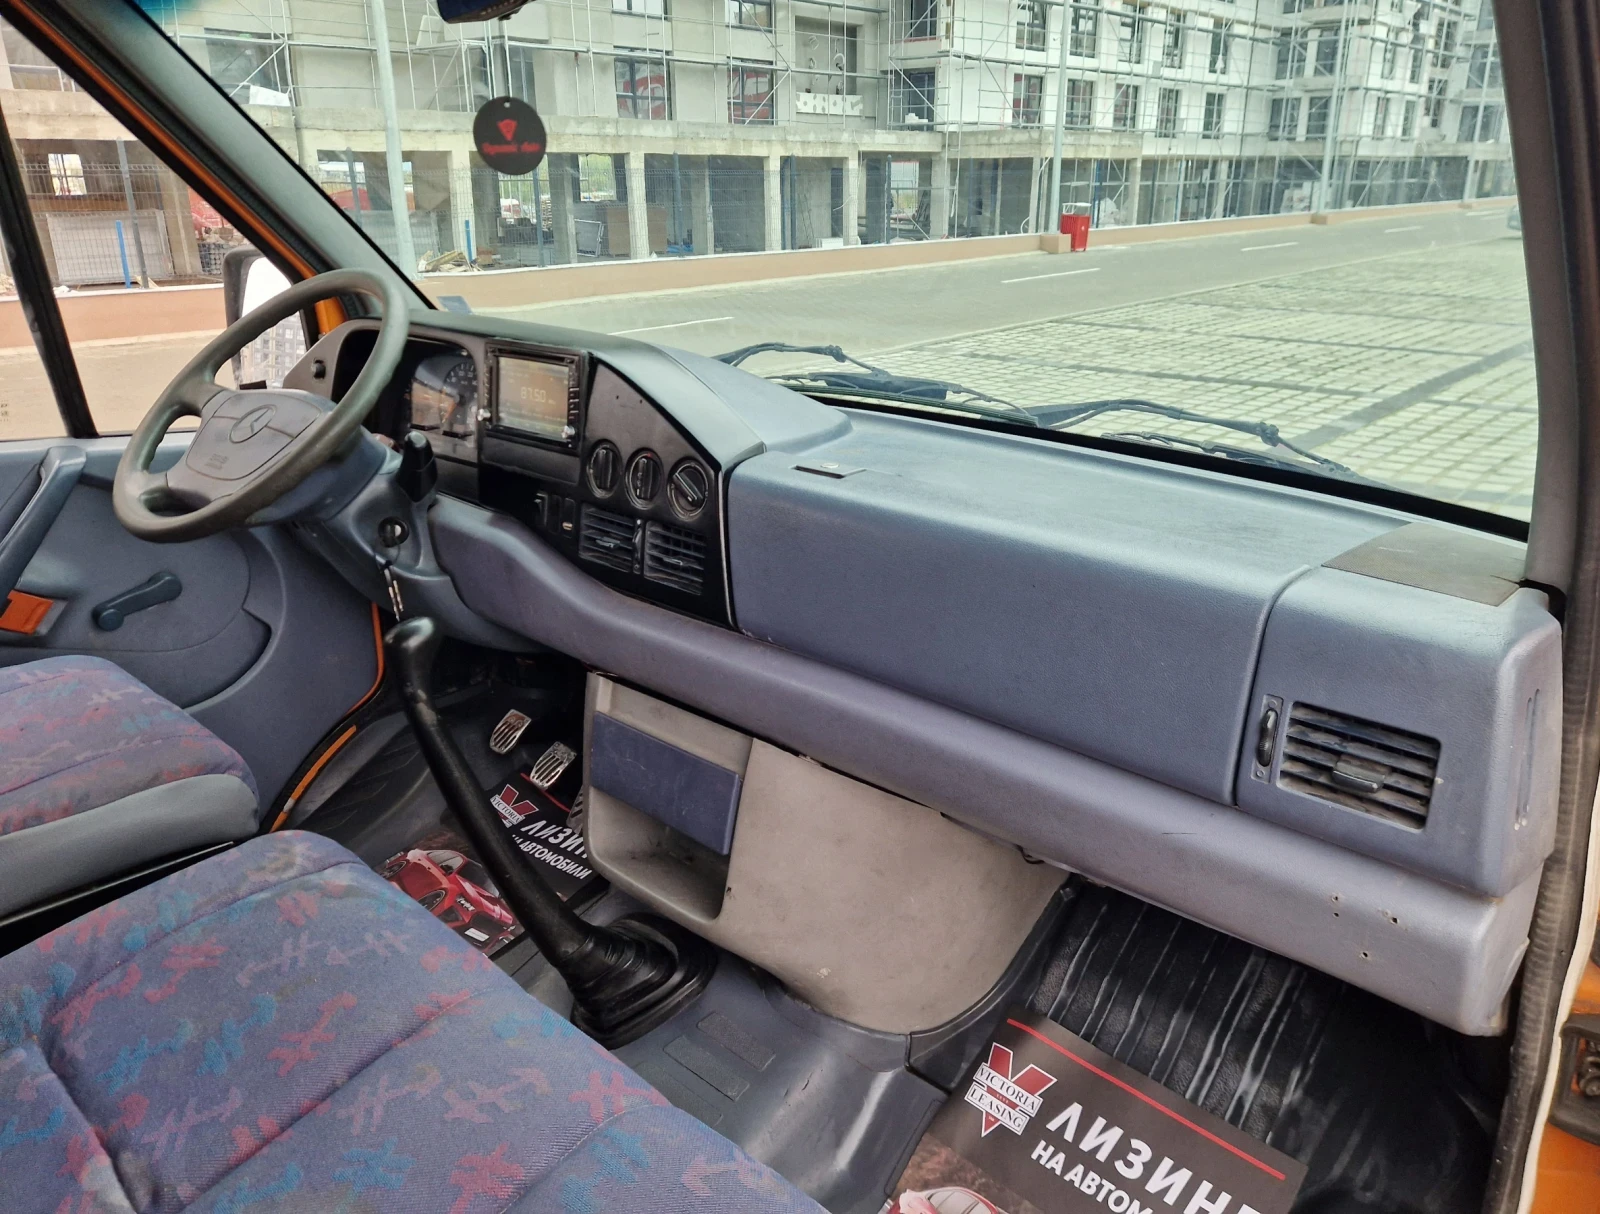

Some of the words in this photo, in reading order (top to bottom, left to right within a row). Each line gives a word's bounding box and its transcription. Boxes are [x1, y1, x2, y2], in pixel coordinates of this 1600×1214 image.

[491, 796, 521, 824] VICTORIA
[519, 841, 593, 880] АВТОМОБИЛИ
[969, 1088, 1024, 1129] LEASING
[980, 1066, 1036, 1111] VICTORIA
[1030, 1139, 1066, 1176] НА
[1045, 1101, 1262, 1214] ЛИЗИН
